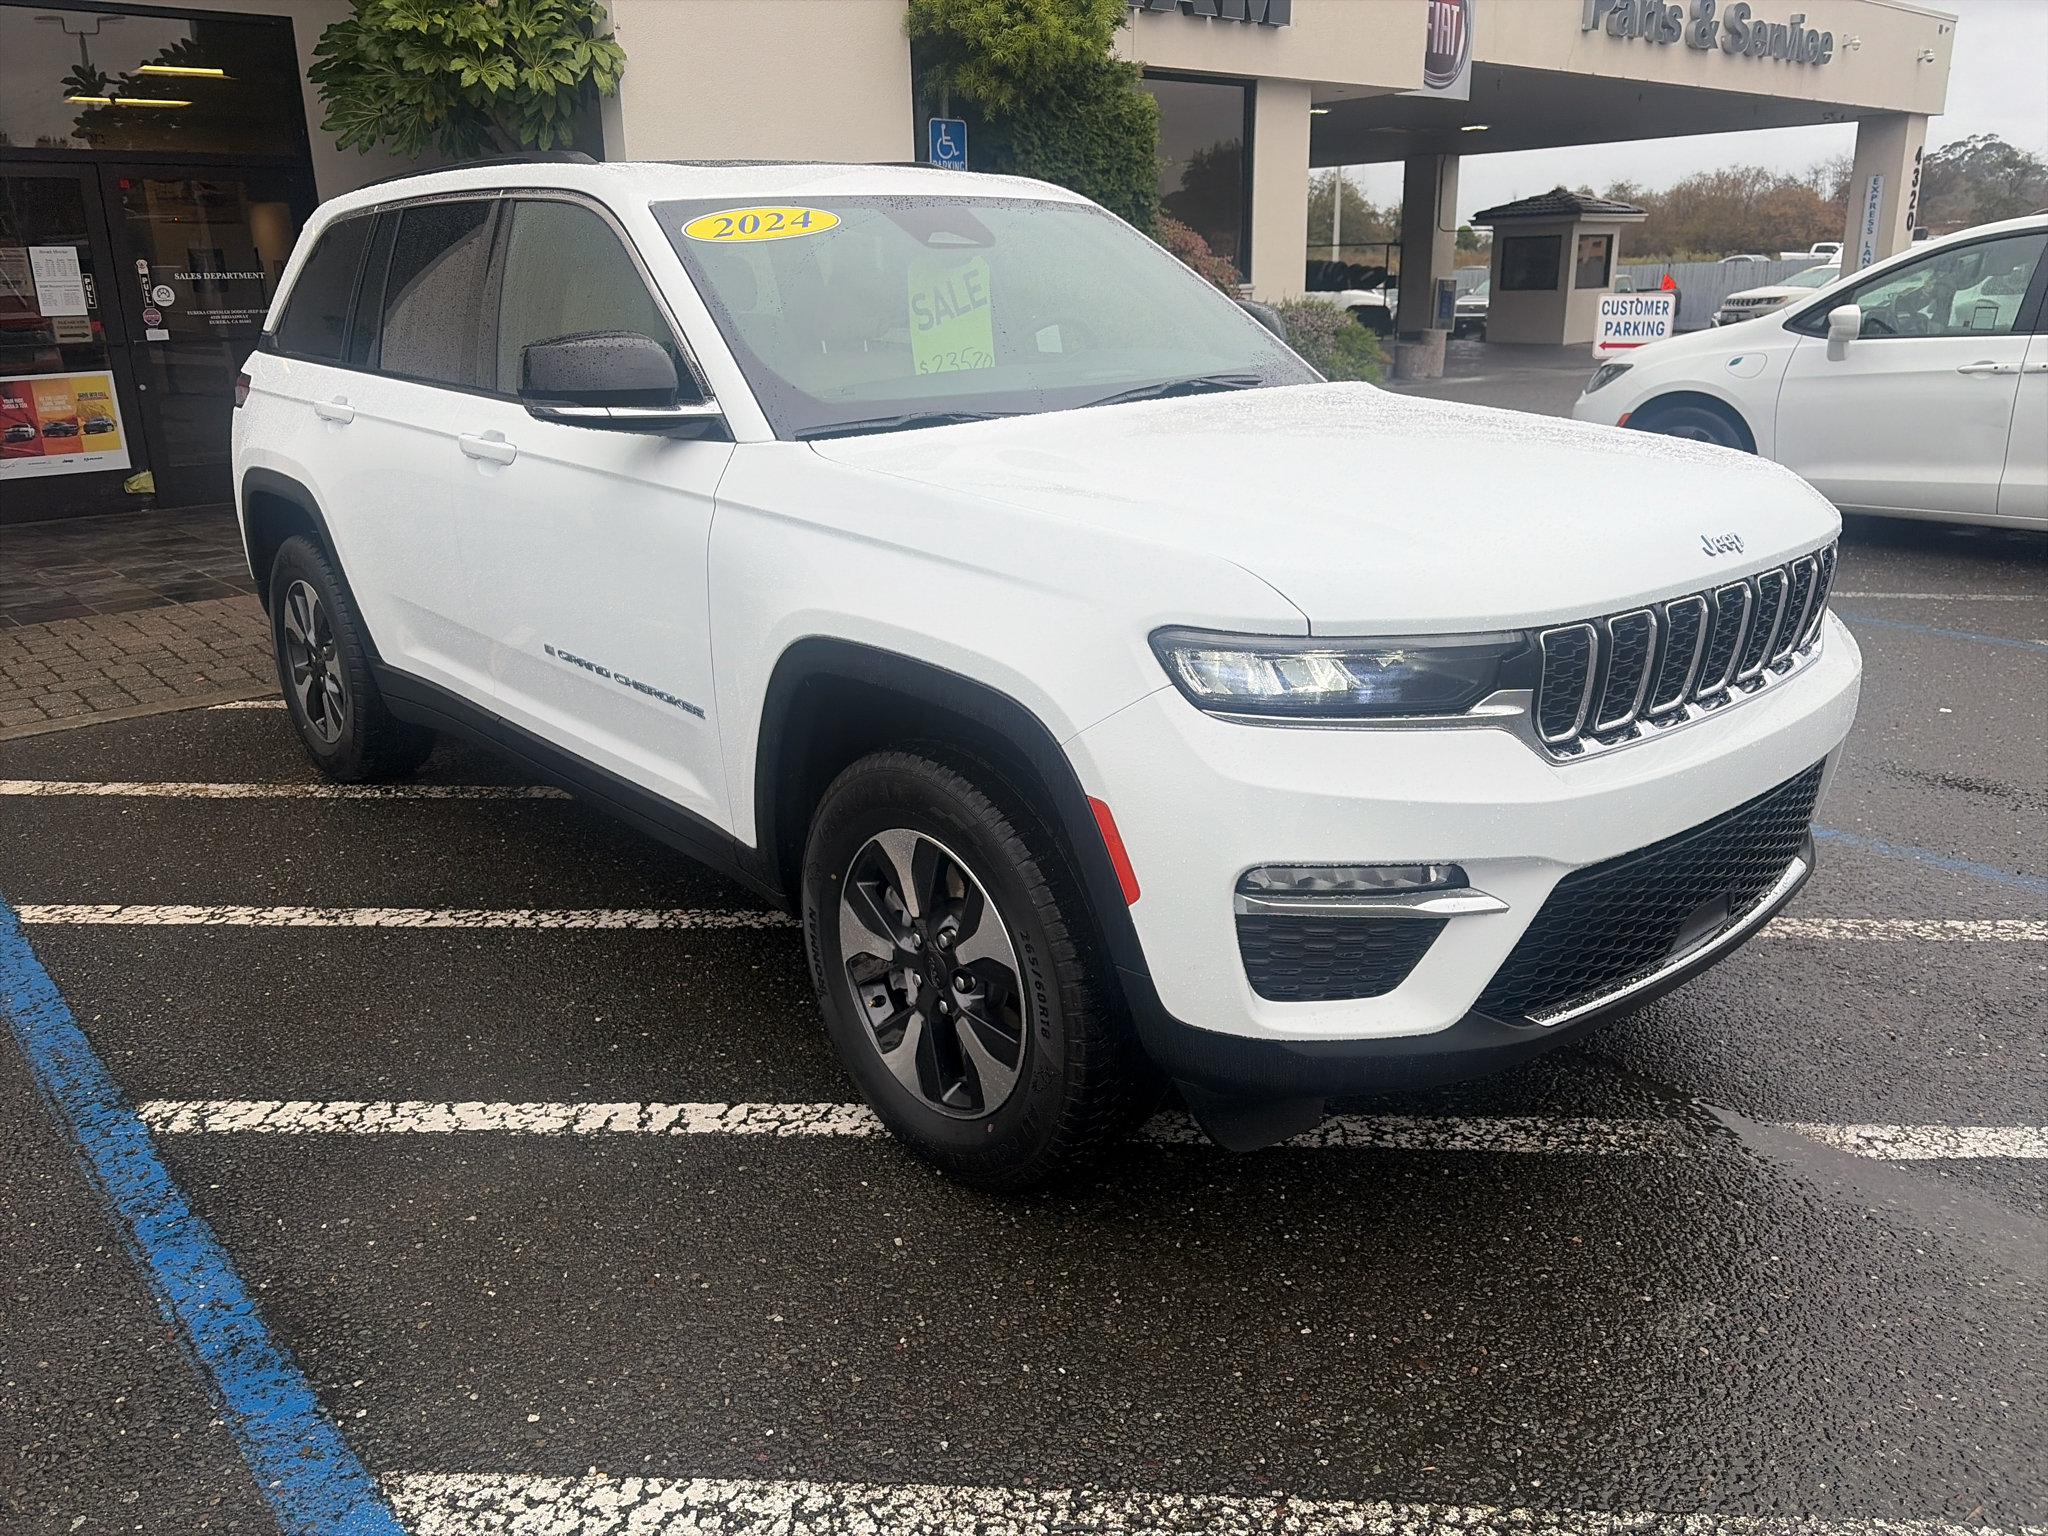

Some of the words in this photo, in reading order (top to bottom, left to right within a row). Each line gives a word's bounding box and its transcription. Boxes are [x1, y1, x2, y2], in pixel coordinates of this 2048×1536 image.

[1684, 0, 1720, 50] &
[1721, 2, 1833, 65] Service
[1906, 145, 1923, 232] 4320
[1867, 177, 1879, 235] EXPRESS
[713, 210, 812, 239] 2024
[1862, 241, 1872, 269] LAN
[174, 272, 202, 280] SALES
[203, 271, 265, 280] DEPARTMENT
[84, 278, 95, 305] PULL
[141, 277, 152, 304] PULL
[911, 268, 988, 331] SALE
[1601, 300, 1669, 316] CUSTOMER
[1604, 321, 1666, 336] PARKING
[1700, 532, 1745, 557] Jeep
[557, 649, 611, 679] GRAND
[613, 672, 706, 721] CHEROKEE
